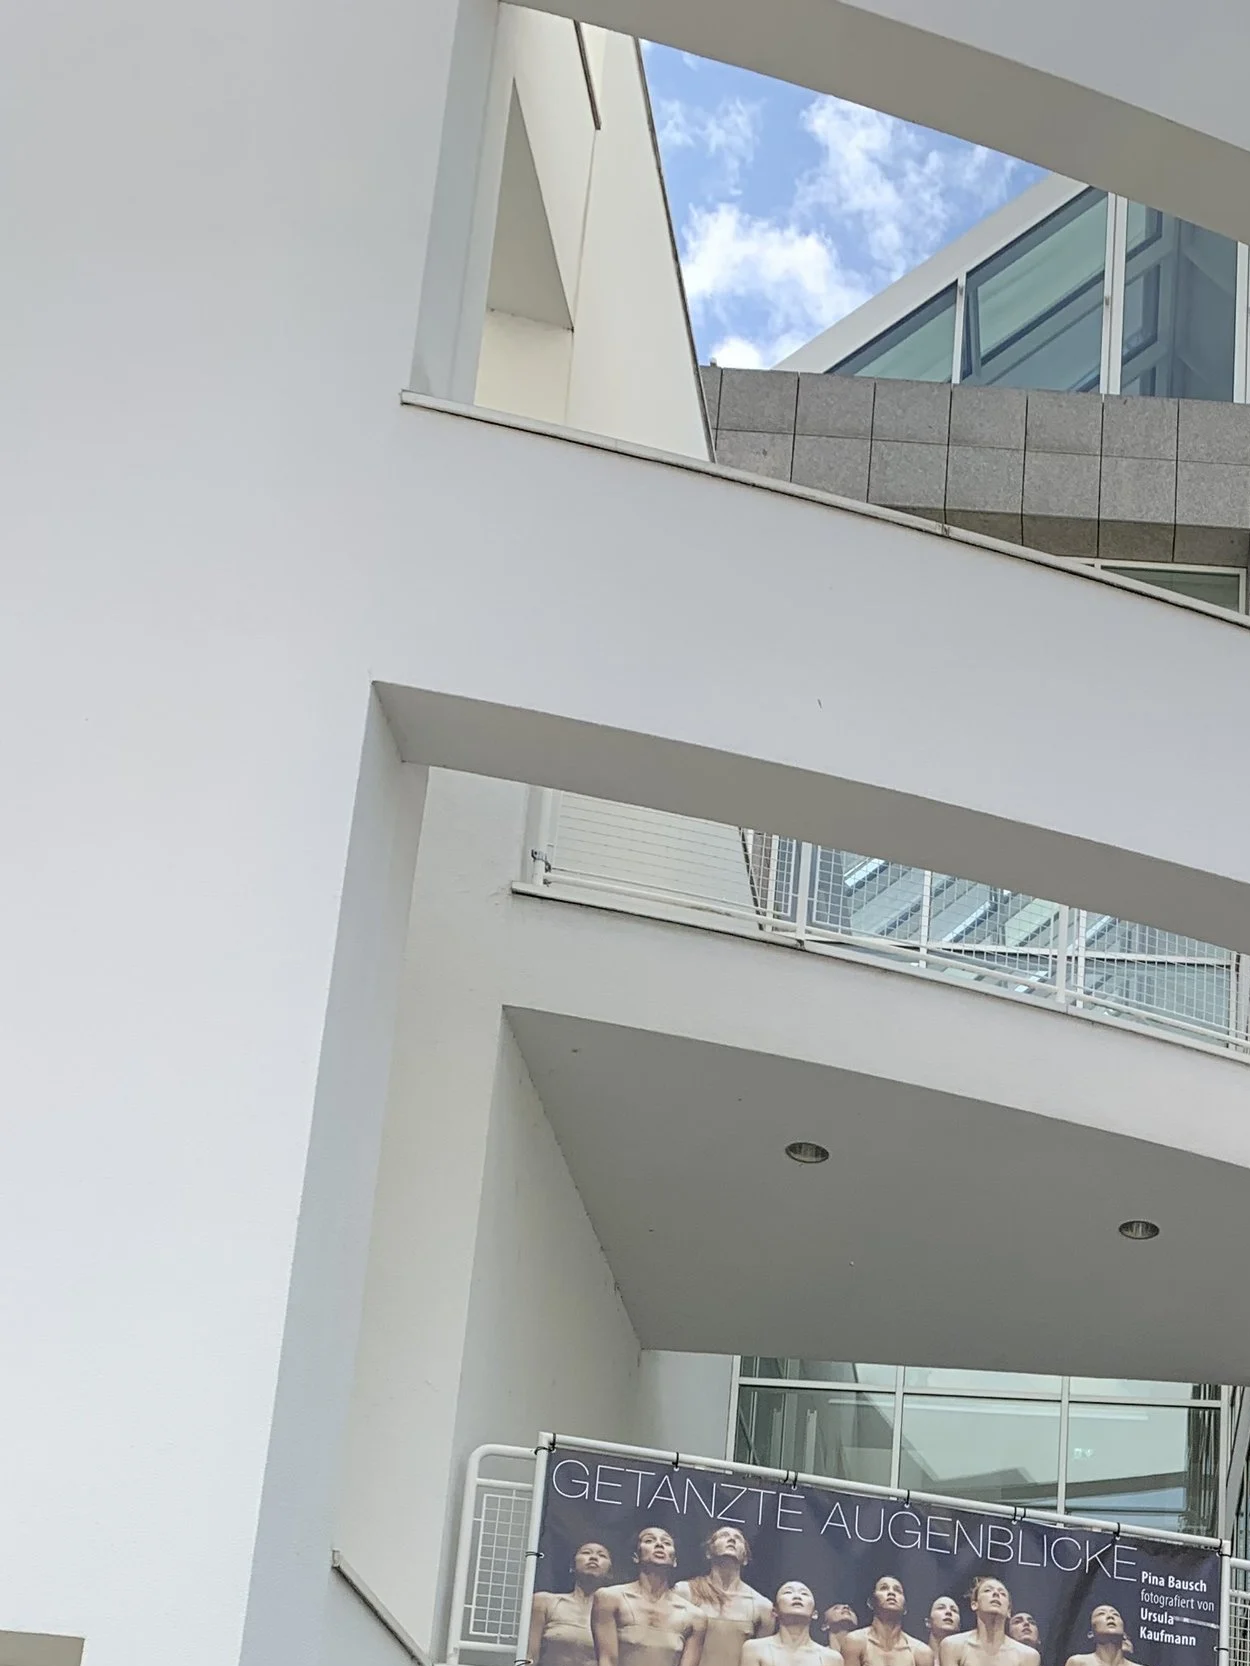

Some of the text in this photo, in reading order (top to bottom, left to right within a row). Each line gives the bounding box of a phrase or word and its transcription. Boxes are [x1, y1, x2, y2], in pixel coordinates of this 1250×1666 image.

[552, 1458, 1138, 1583] GETANZTE AUGENBLICKE
[1141, 1570, 1207, 1593] Pina Bausch
[1140, 1588, 1215, 1612] fotografiert von
[1140, 1607, 1174, 1625] Ursula
[1139, 1625, 1196, 1646] Kaufmann
